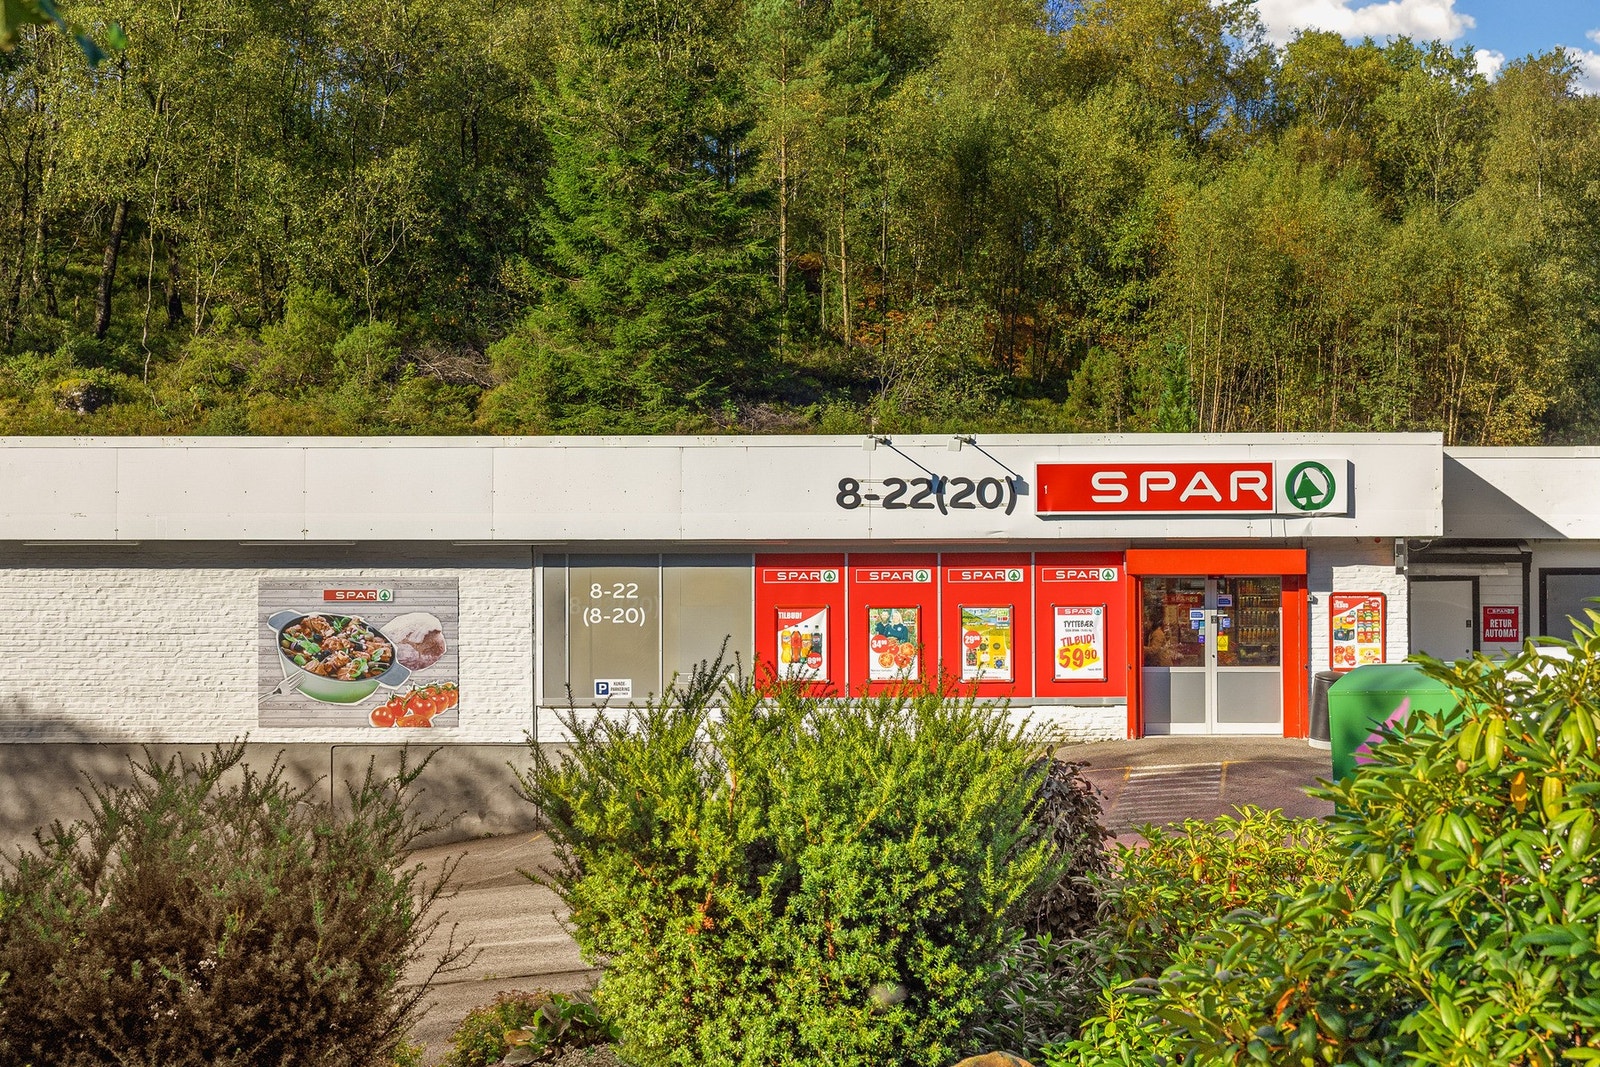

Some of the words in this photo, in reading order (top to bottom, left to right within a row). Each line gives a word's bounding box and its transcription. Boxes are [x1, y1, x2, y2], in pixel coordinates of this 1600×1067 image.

[1091, 470, 1268, 503] SPAR
[836, 476, 1018, 516] 8-22(20)
[777, 571, 821, 581] SPAR
[869, 571, 913, 581] SPAR
[961, 570, 1005, 580] SPAR
[1055, 570, 1099, 580] SPAR
[335, 591, 376, 600] SPAR
[590, 582, 639, 599] 8-22
[1064, 607, 1093, 615] SPAR
[583, 607, 646, 627] (8-20)
[1063, 620, 1094, 628] TYTTEBÆR
[1489, 619, 1512, 628] RETUR
[1484, 629, 1517, 638] AUTOMAT
[1060, 633, 1095, 647] TILBUD!
